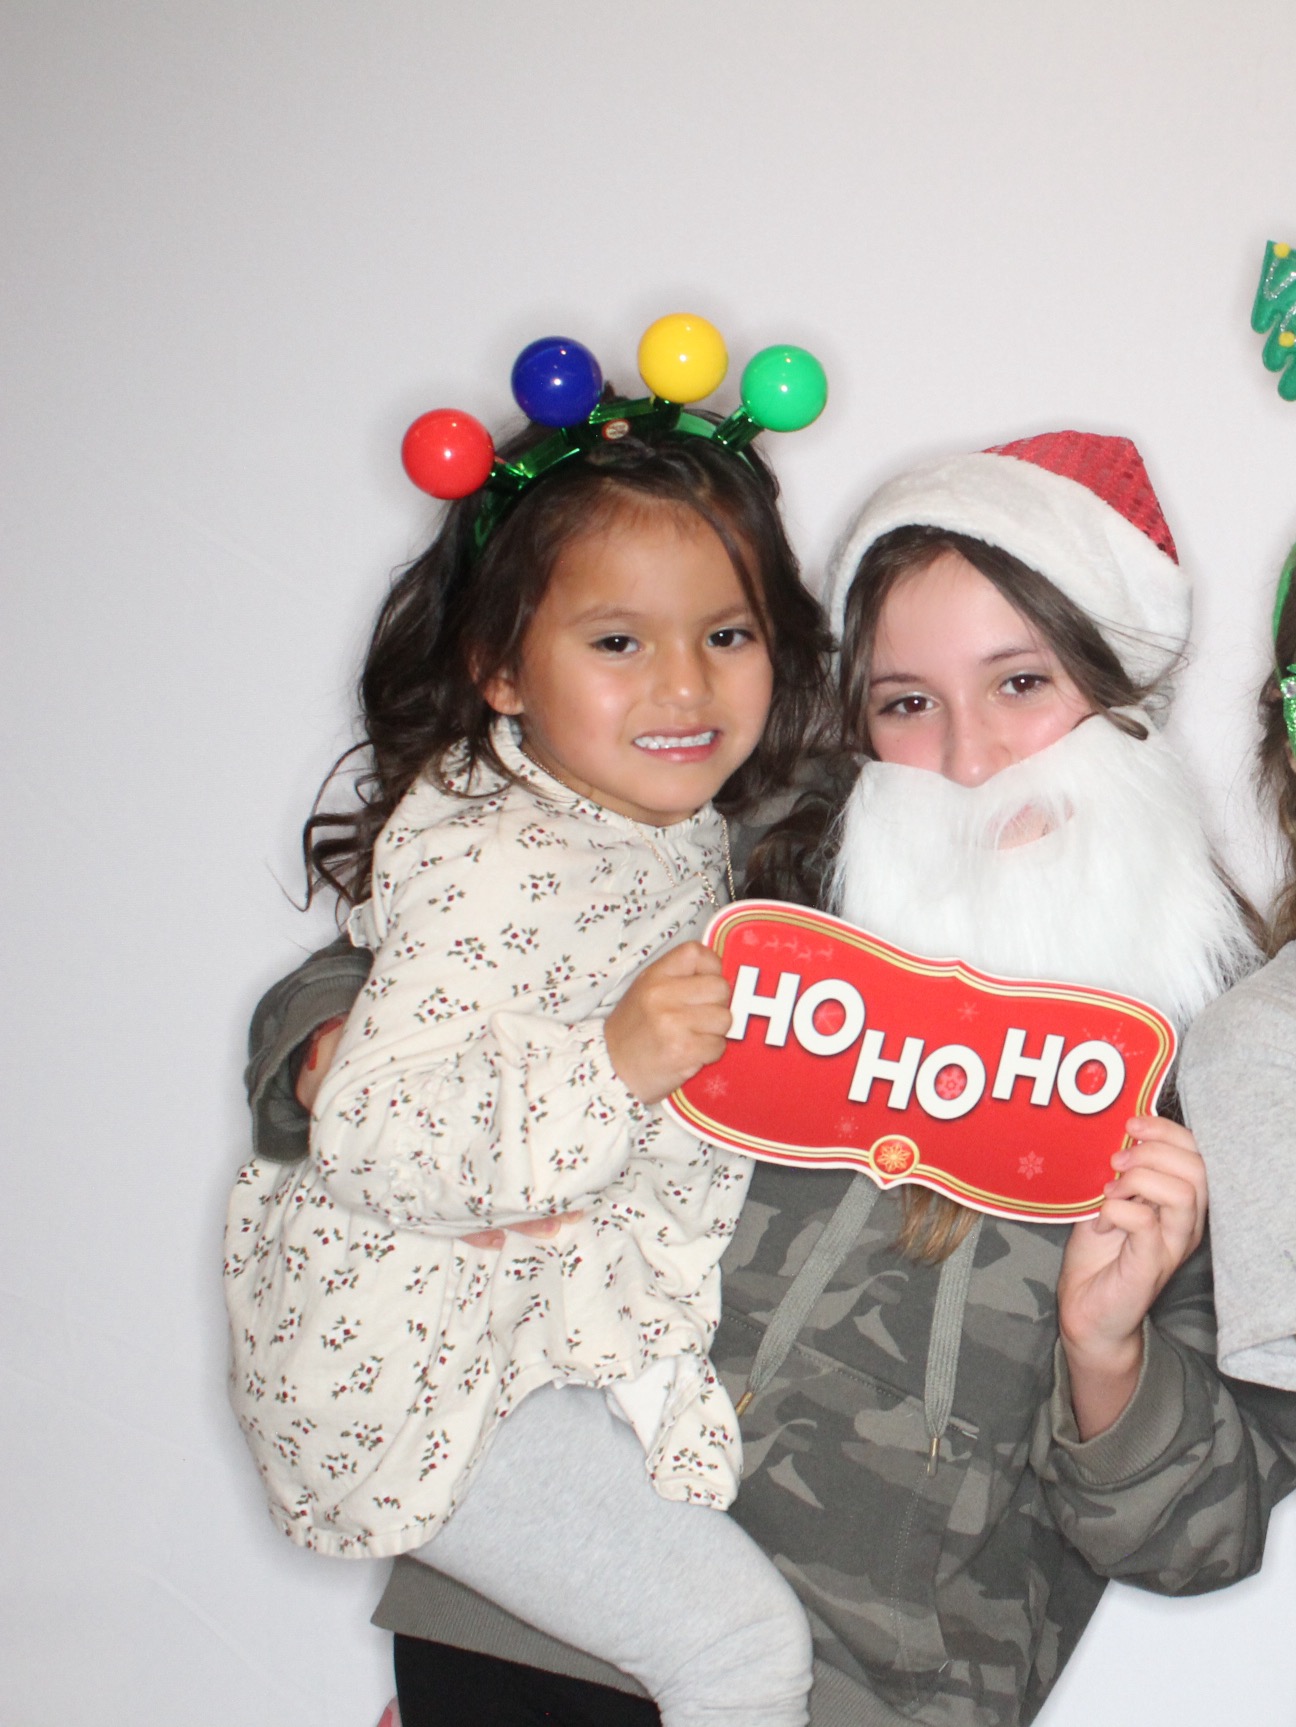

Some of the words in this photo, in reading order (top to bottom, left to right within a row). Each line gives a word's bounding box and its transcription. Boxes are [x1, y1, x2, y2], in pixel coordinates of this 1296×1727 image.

[726, 965, 866, 1056] HO
[848, 1029, 986, 1120] HO
[992, 1028, 1125, 1114] HO
